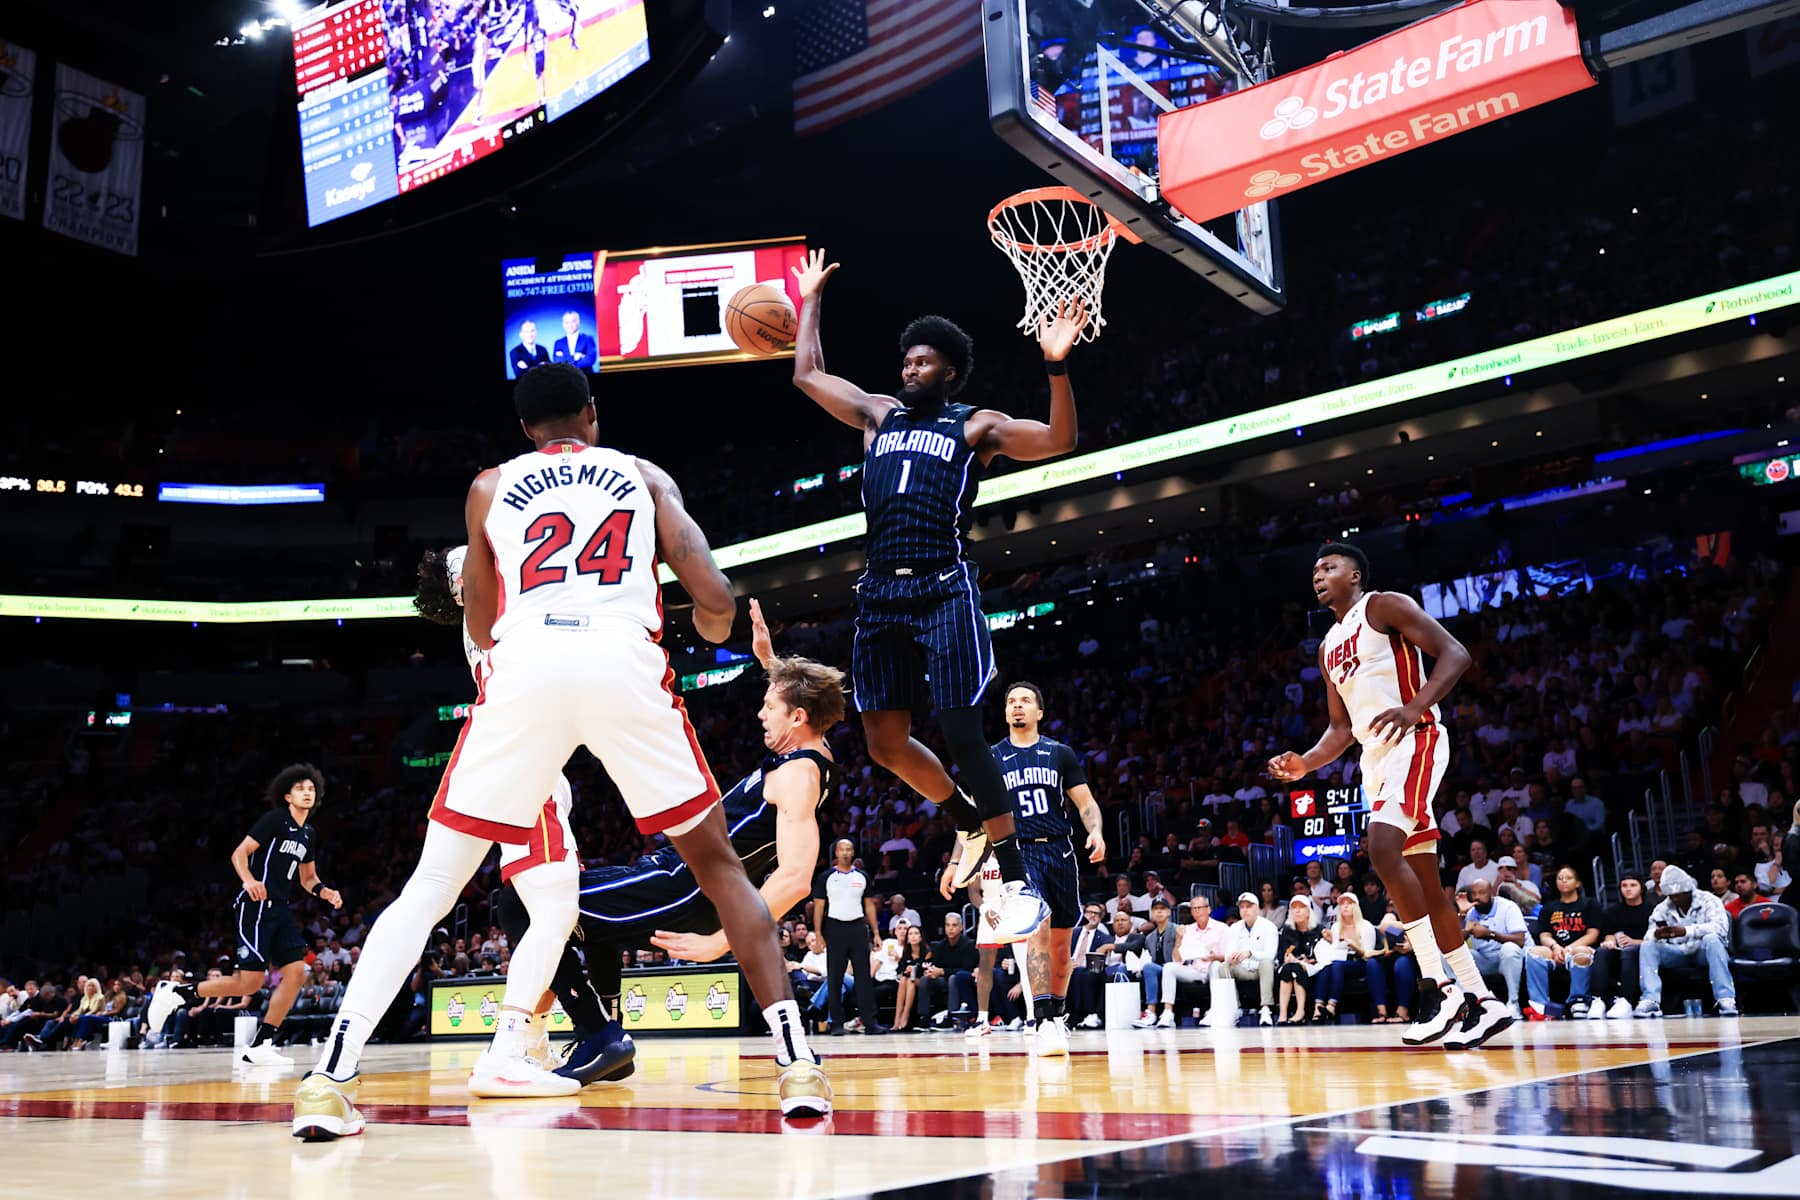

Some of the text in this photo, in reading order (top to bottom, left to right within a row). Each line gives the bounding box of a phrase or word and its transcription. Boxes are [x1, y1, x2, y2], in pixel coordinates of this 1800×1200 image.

[325, 177, 376, 208] Kaseya
[506, 272, 593, 287] ACCIDENT ATTORNEYS
[1719, 282, 1793, 313] Robinhood
[1460, 351, 1522, 377] Robinhood
[875, 429, 957, 463] ORLANDO
[76, 480, 109, 495] FG%
[114, 483, 144, 497] 43.2
[503, 463, 637, 512] HIGHSMITH
[896, 459, 912, 494] 1
[519, 509, 636, 595] 24
[1327, 623, 1362, 672] HEAT
[1018, 787, 1049, 818] 50
[1326, 787, 1358, 806] 9:41
[1304, 817, 1325, 836] 80
[1334, 814, 1344, 828] 4
[286, 859, 298, 881] 0
